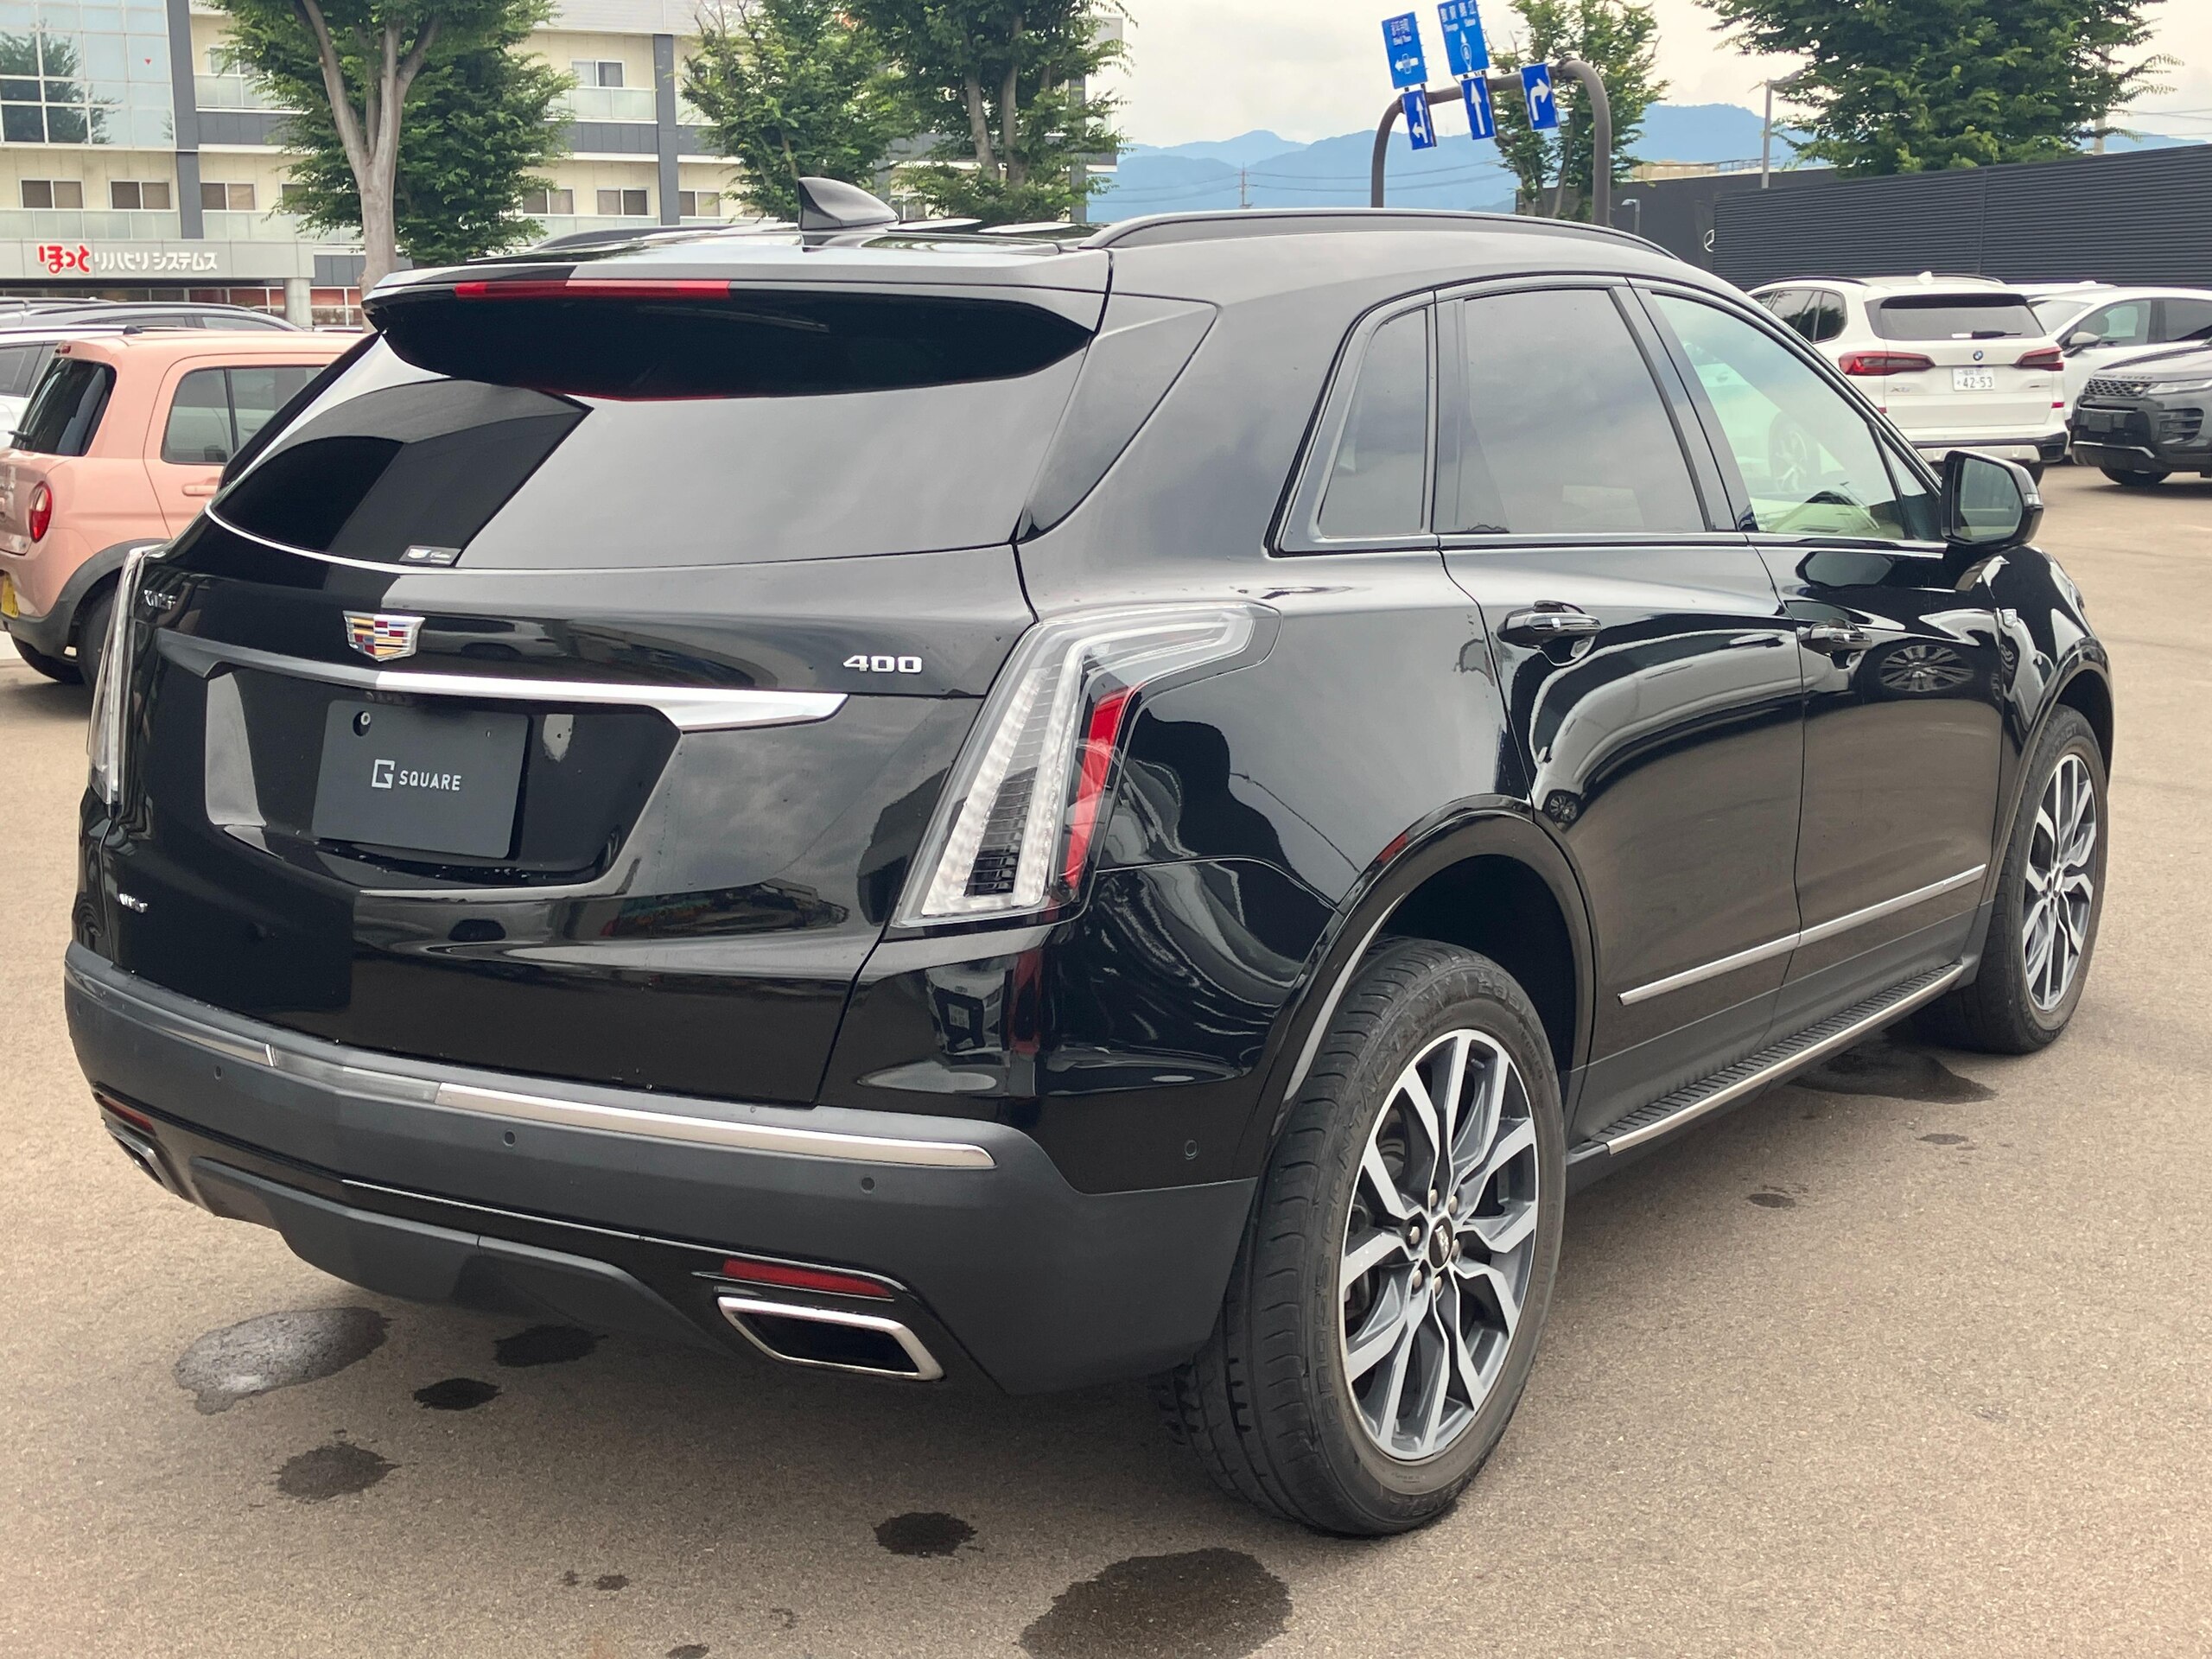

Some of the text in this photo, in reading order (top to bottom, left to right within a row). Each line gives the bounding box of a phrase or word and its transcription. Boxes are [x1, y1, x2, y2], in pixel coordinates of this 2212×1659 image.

[37, 244, 91, 275] ほっと
[1962, 377, 1993, 389] 42-53
[842, 655, 923, 673] 400
[398, 769, 461, 791] SQUARE
